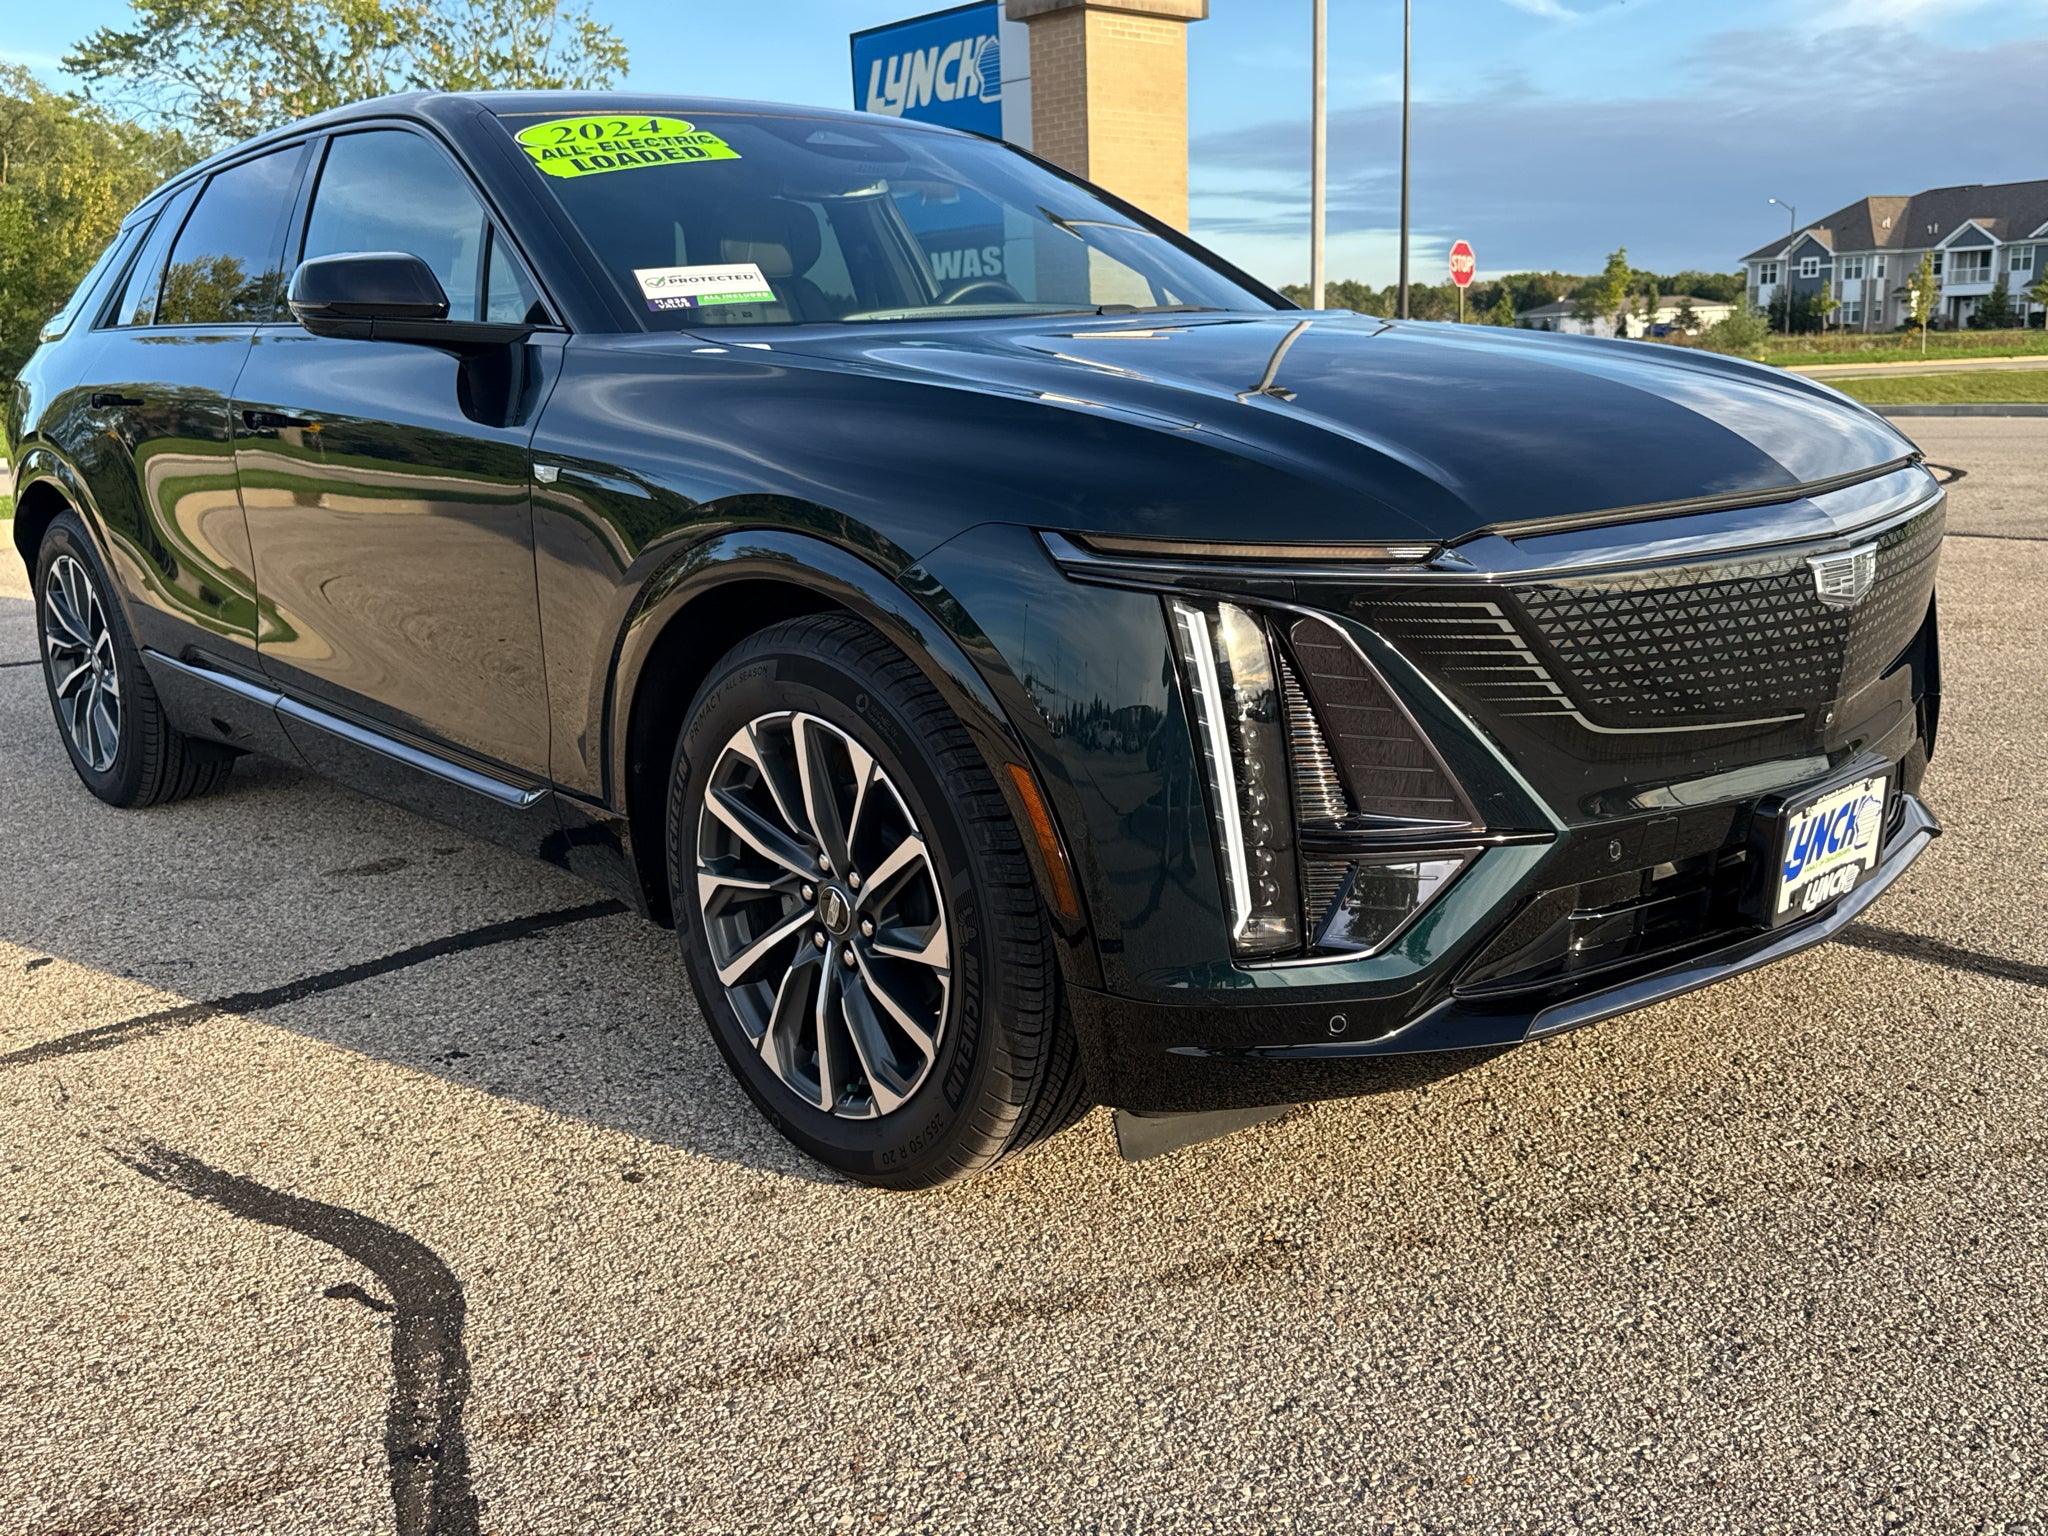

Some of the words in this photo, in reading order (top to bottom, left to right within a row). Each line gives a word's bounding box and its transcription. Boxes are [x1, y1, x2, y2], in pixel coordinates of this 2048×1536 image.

[866, 35, 986, 119] LYNCH
[550, 119, 662, 145] 2024
[541, 134, 717, 160] ALL-ELECTRIC
[572, 146, 709, 172] LOADED
[1451, 255, 1474, 272] STOP
[668, 274, 754, 284] PROTECTED
[689, 687, 722, 744] PRIMACY
[725, 680, 737, 691] ALL
[738, 664, 769, 683] SEASON
[669, 754, 688, 889] MICHELIN
[1802, 865, 1852, 912] LYNCH
[945, 950, 980, 1102] MICHELIN
[909, 1112, 944, 1153] 265/50
[882, 1150, 896, 1165] 20
[898, 1145, 908, 1159] R
